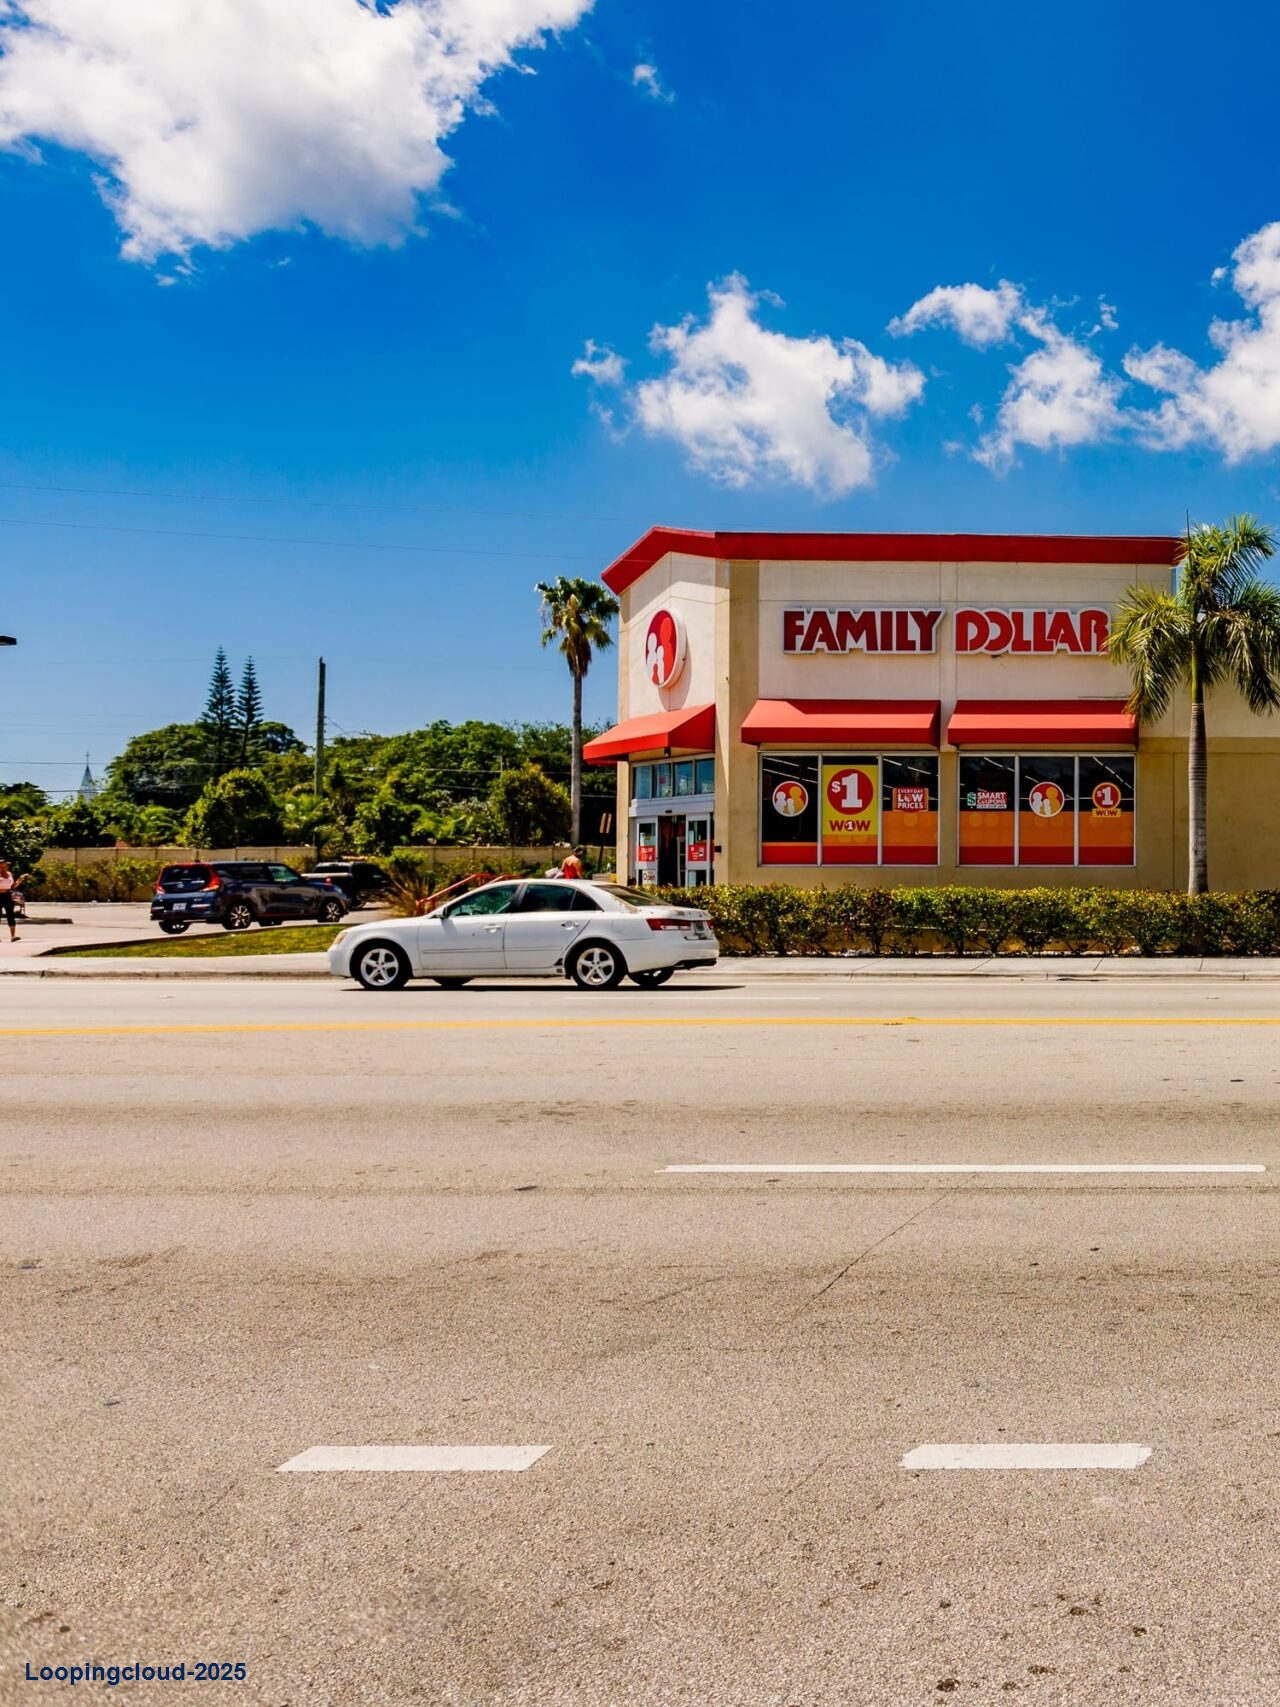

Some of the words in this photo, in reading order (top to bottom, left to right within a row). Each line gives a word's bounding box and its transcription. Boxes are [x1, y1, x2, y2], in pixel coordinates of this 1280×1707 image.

[783, 609, 944, 652] FAMILY
[955, 609, 1110, 652] DOLLAR
[831, 773, 863, 808] $1
[897, 793, 924, 802] LOW
[977, 791, 1006, 800] SMART
[1096, 786, 1114, 806] $1
